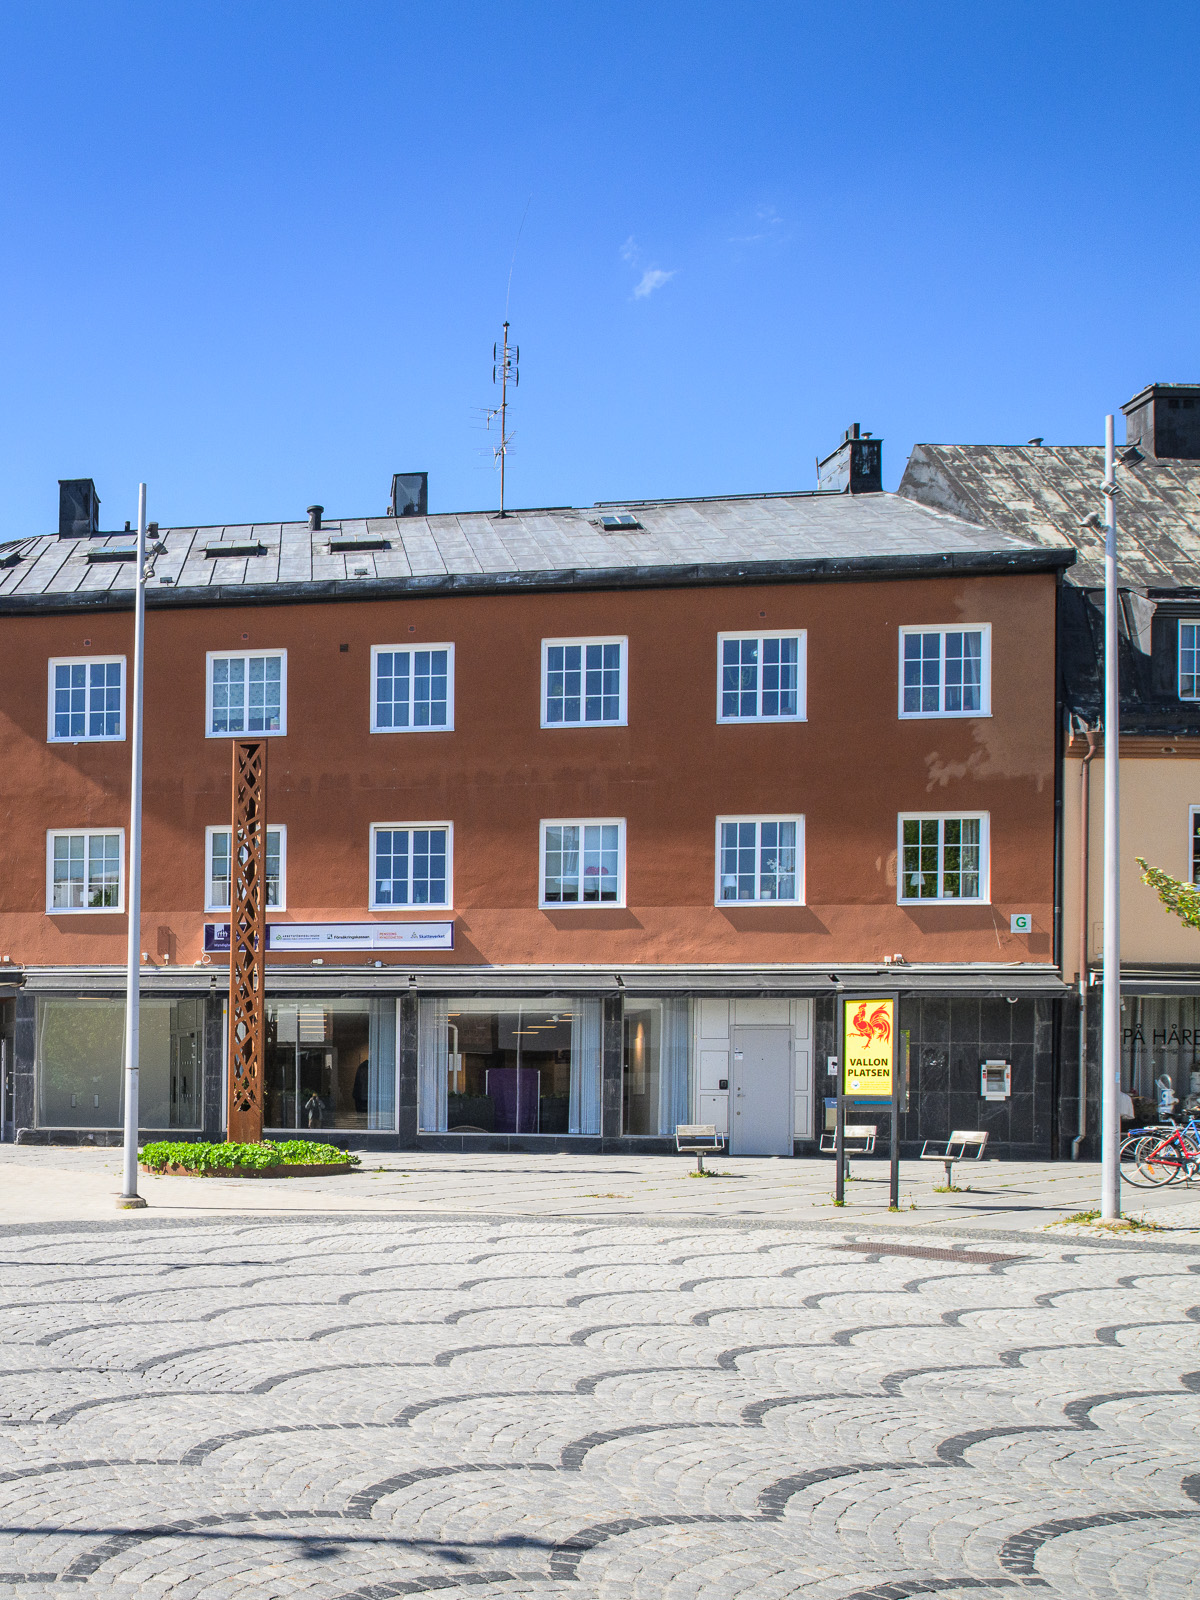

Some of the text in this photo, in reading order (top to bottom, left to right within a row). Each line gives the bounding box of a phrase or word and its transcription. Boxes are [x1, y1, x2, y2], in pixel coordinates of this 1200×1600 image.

[1015, 916, 1027, 928] G
[1123, 1023, 1145, 1045] PÅ
[849, 1058, 888, 1066] VALLON
[847, 1068, 890, 1077] PLATSEN
